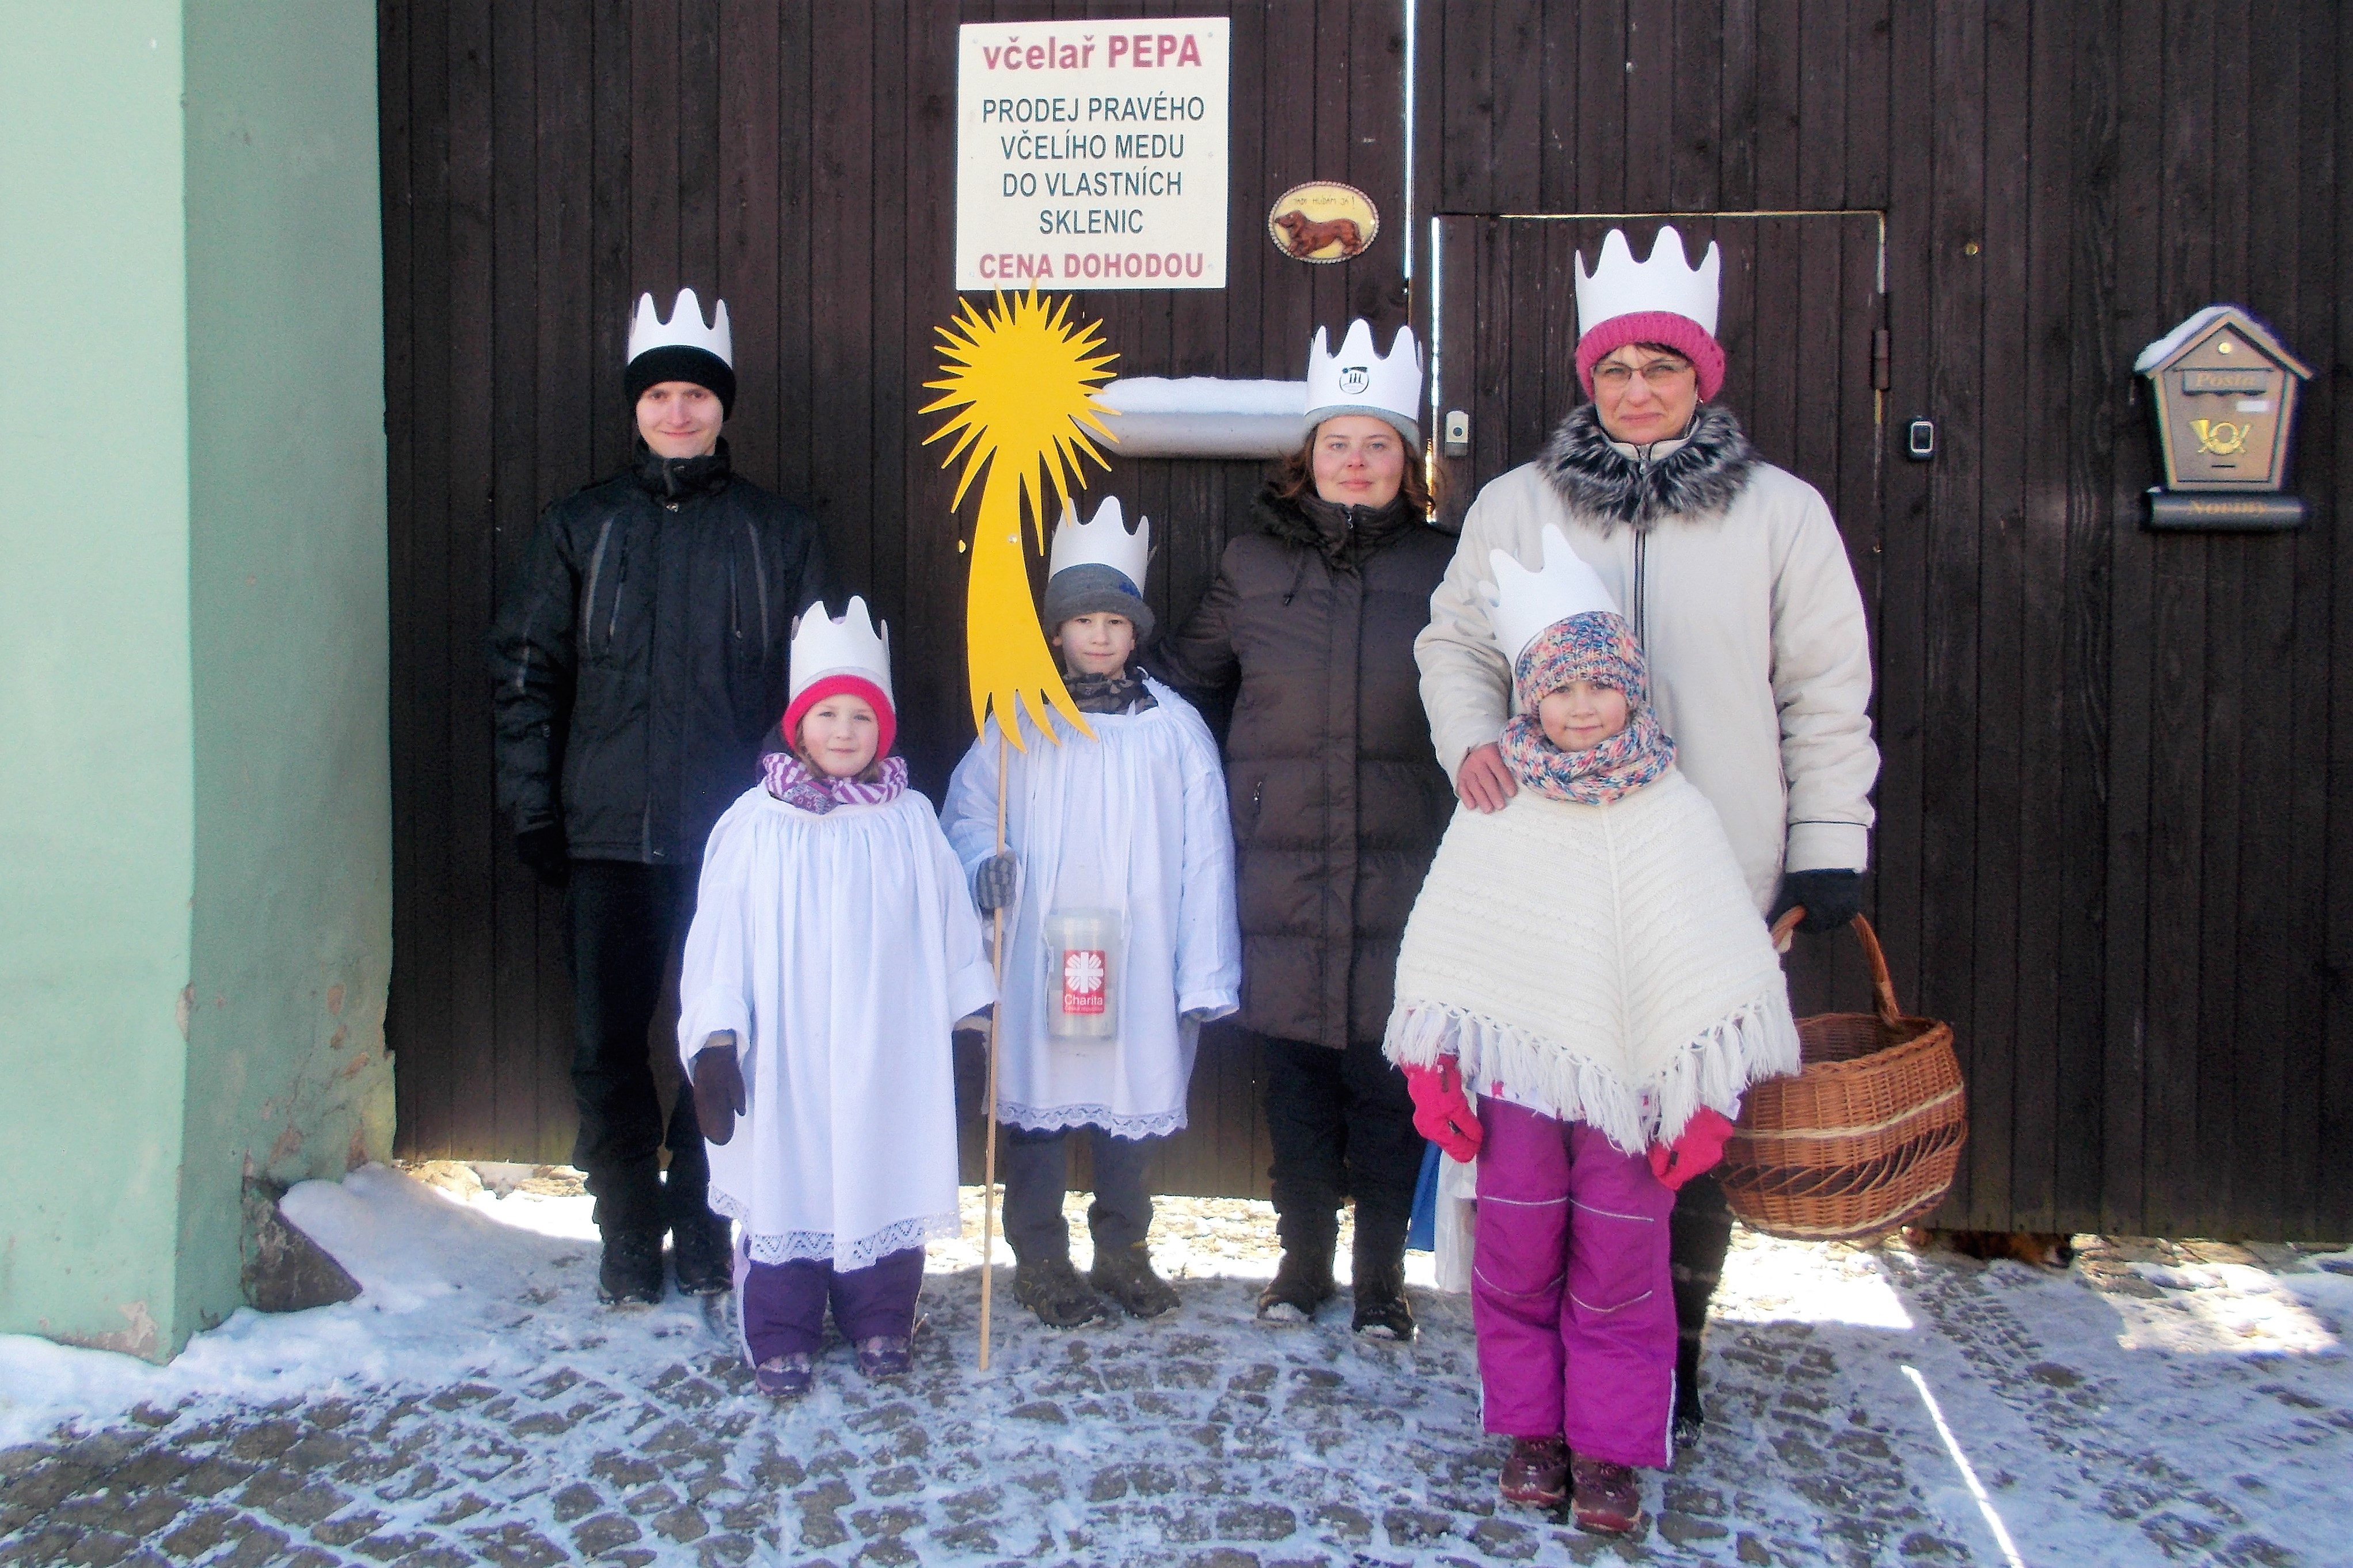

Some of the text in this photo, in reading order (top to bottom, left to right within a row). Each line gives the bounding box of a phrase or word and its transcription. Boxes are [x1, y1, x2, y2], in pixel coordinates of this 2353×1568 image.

[983, 34, 1202, 70] včelař PEPA
[983, 91, 1204, 123] PRODEJ PRAVÉHO
[1001, 129, 1184, 160] VČELÍHO MEDU
[1003, 166, 1182, 197] DO VLASTNÍCH
[1039, 210, 1143, 234] SKLENIC
[979, 253, 1203, 279] CENA DOHODOU
[1065, 994, 1103, 1006] Charita
